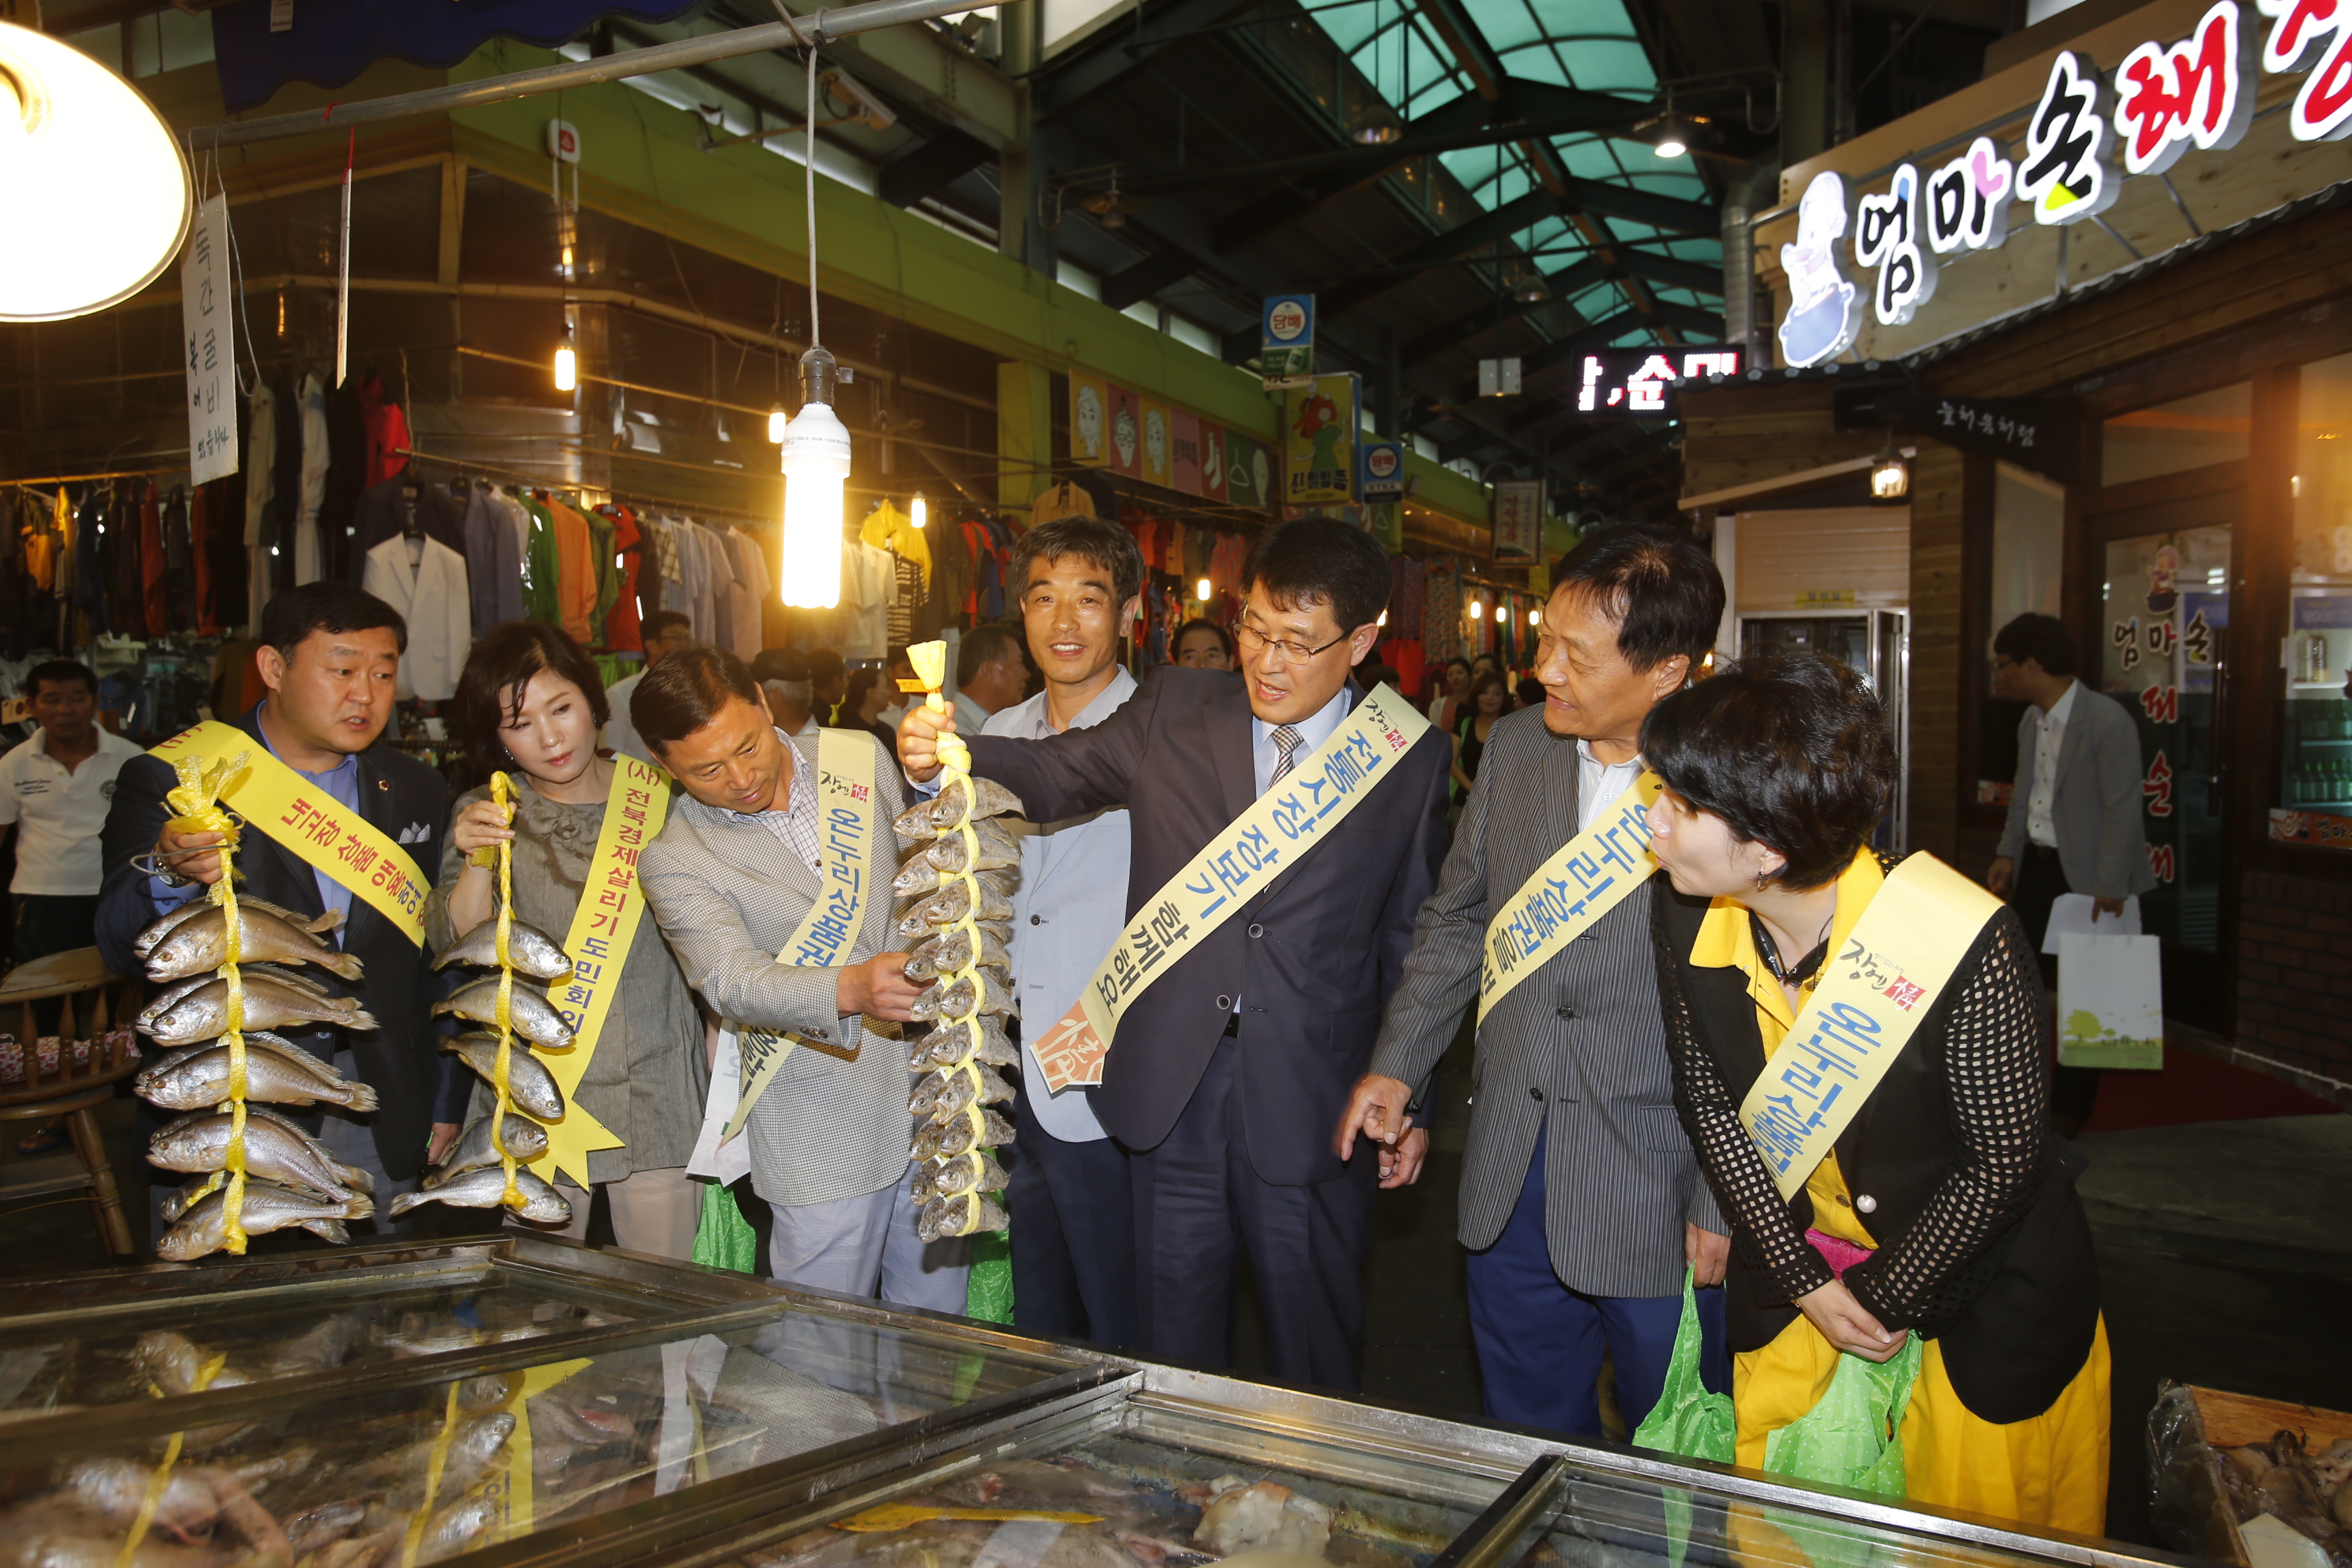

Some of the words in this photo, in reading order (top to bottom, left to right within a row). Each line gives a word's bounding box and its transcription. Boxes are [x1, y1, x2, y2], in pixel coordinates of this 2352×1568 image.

[1273, 314, 1302, 331] 담배
[2114, 612, 2210, 666] 엄마손
[1272, 729, 1382, 839] 전통시장
[280, 797, 342, 847] 내고장
[338, 834, 379, 874] 상품
[2316, 819, 2352, 840] 엄마
[1186, 823, 1281, 920] 장보기
